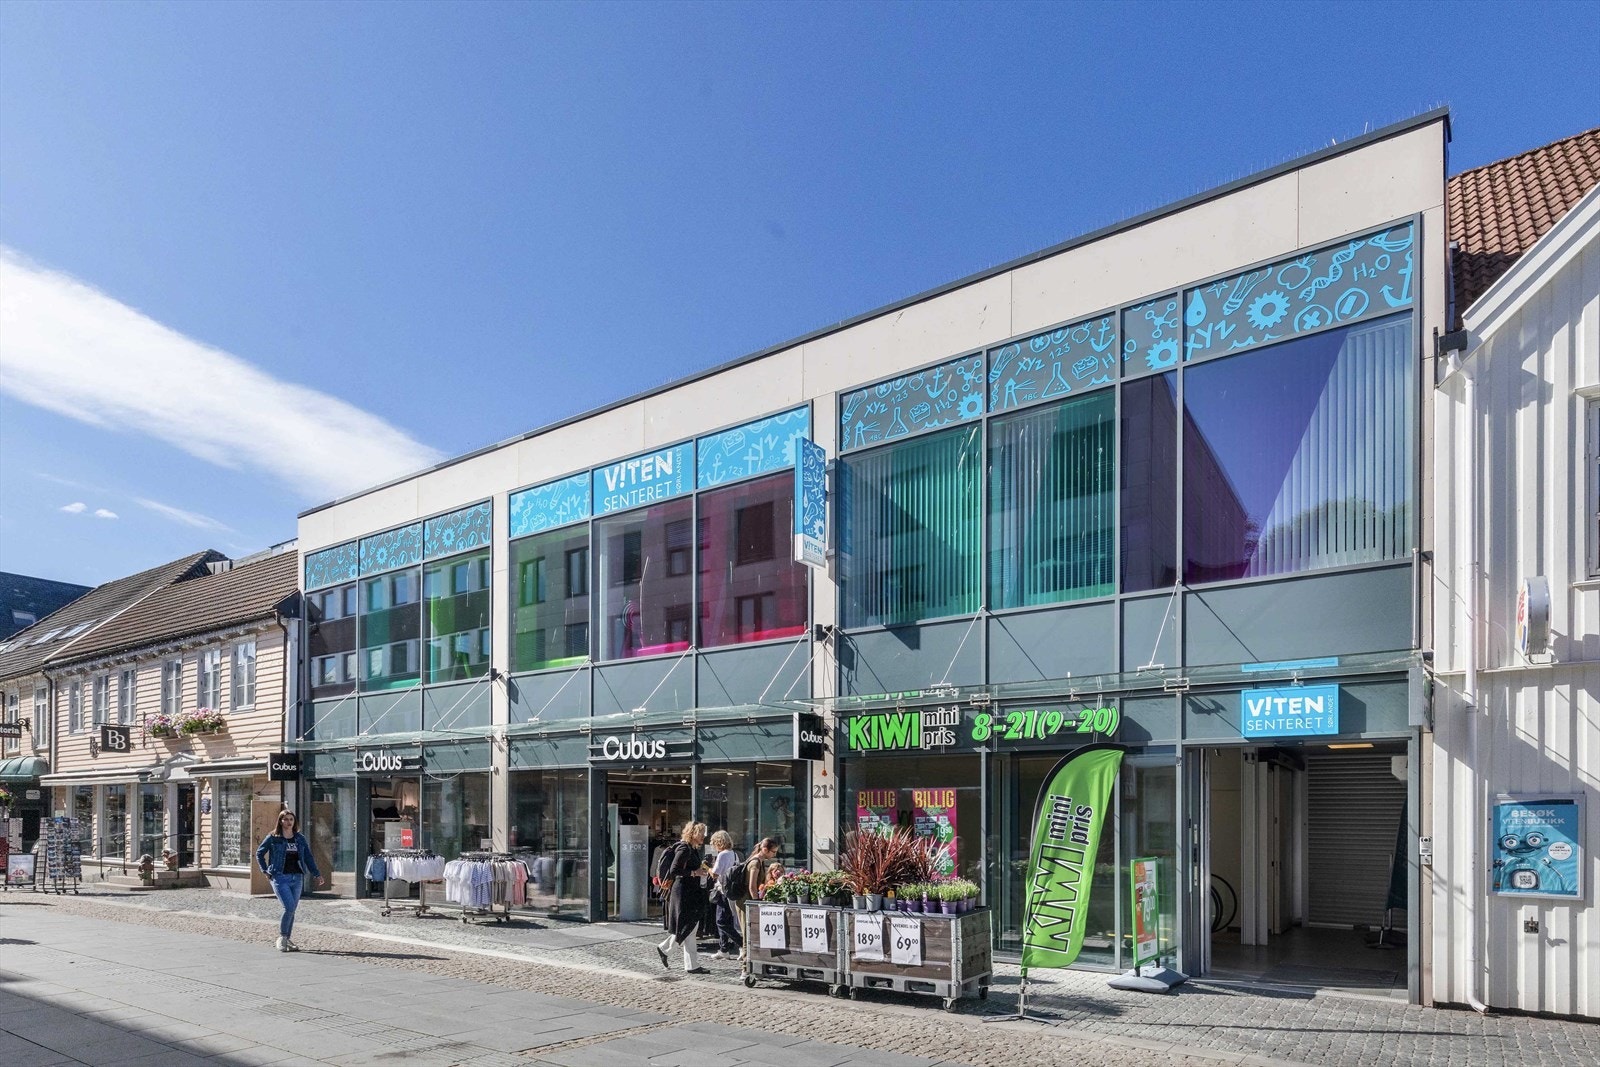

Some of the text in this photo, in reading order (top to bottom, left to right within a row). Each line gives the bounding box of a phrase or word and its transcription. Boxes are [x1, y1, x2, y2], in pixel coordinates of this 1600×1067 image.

[1049, 342, 1071, 359] 123
[891, 390, 909, 404] 123
[603, 481, 673, 512] SENTERET
[849, 705, 960, 751] KIWI mini
[1246, 717, 1323, 732] SENTERET
[800, 730, 823, 744] Cubus
[923, 726, 956, 750] pris
[603, 733, 666, 760] Cubus
[272, 763, 297, 771] Cubus
[362, 750, 402, 771] Cubus
[858, 791, 895, 808] BILLIG
[914, 790, 955, 808] BILLIG
[1047, 794, 1072, 841] mini
[1511, 809, 1555, 818] BESØK
[1069, 804, 1093, 846] pris
[622, 843, 628, 851] 3
[1023, 843, 1085, 954] KIWI
